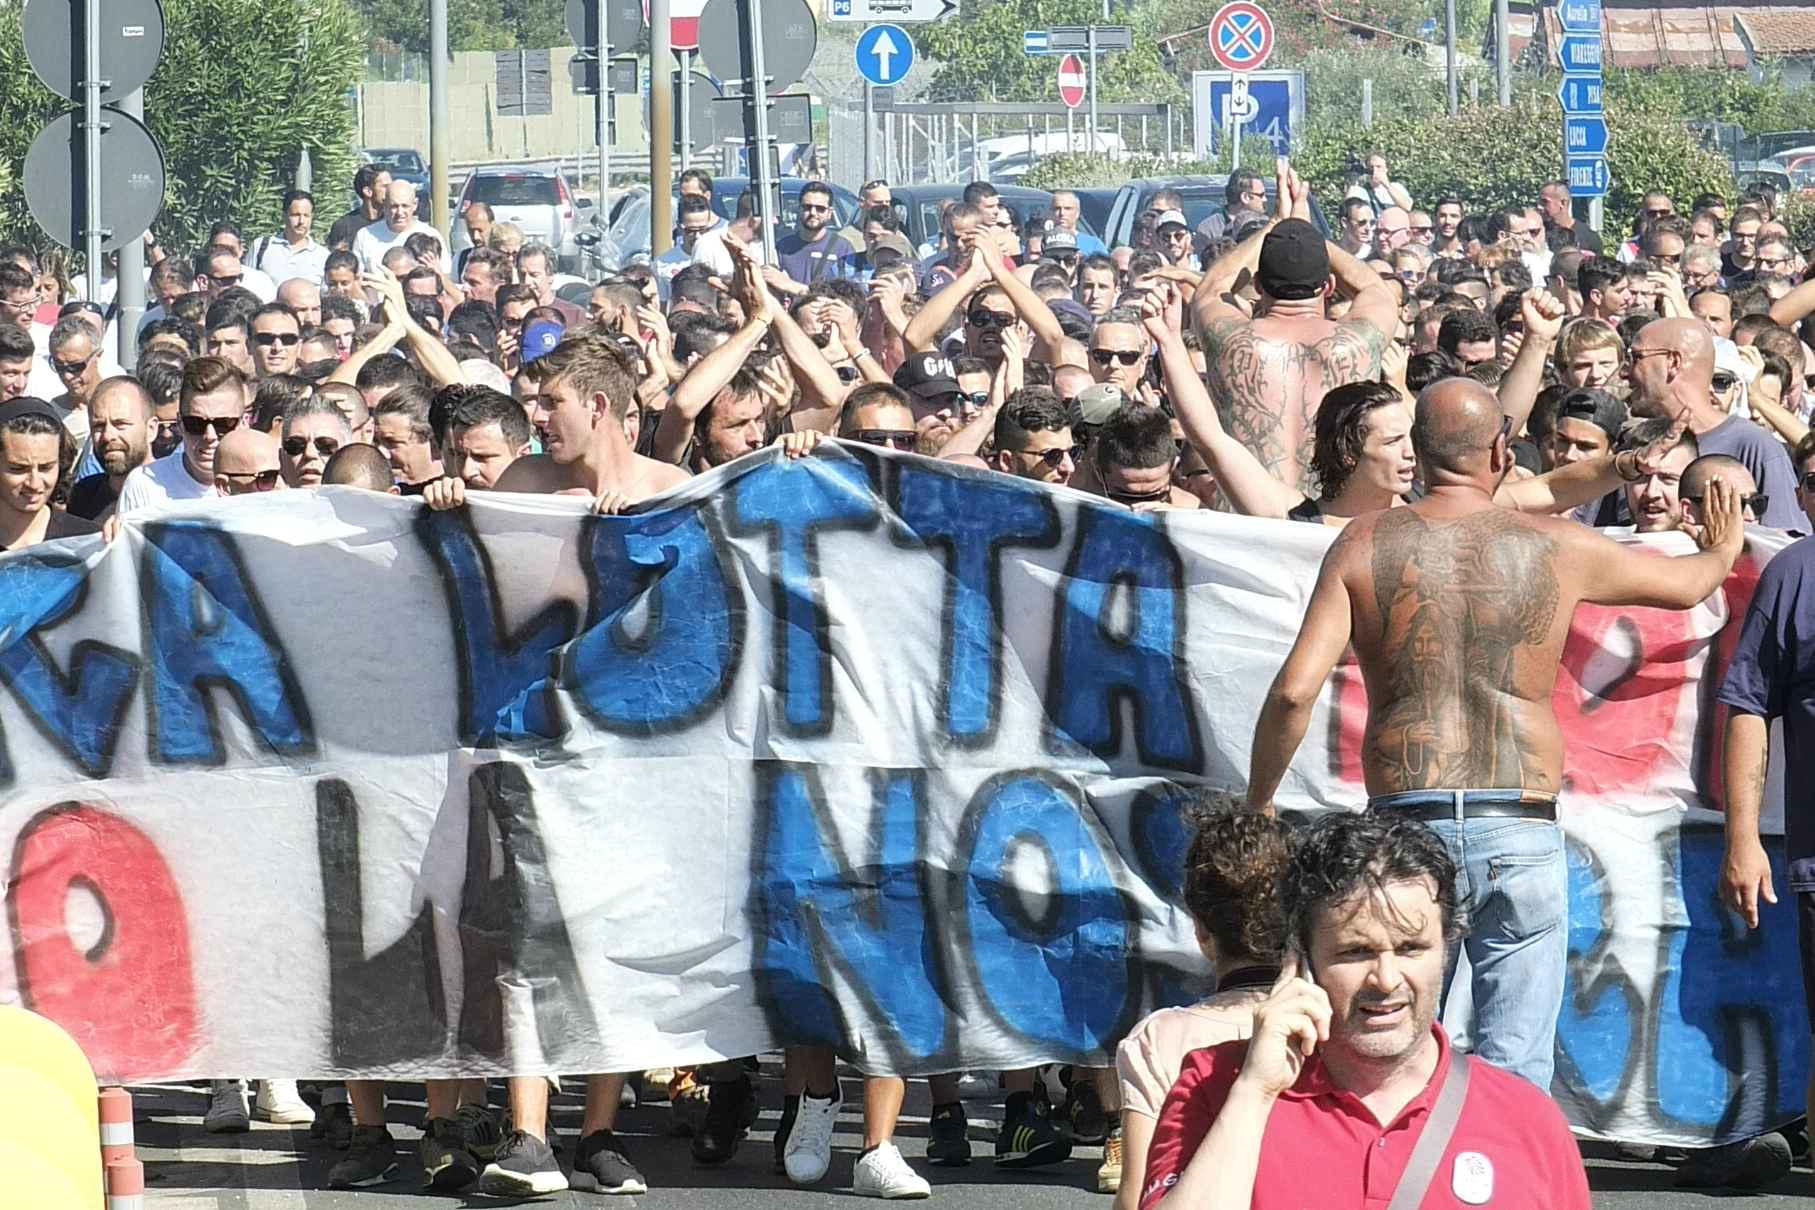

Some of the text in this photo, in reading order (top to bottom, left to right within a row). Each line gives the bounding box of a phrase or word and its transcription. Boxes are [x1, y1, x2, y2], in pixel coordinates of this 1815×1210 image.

[834, 1, 850, 13] P6
[414, 446, 1205, 776] LOTTA
[314, 759, 600, 1068] LA
